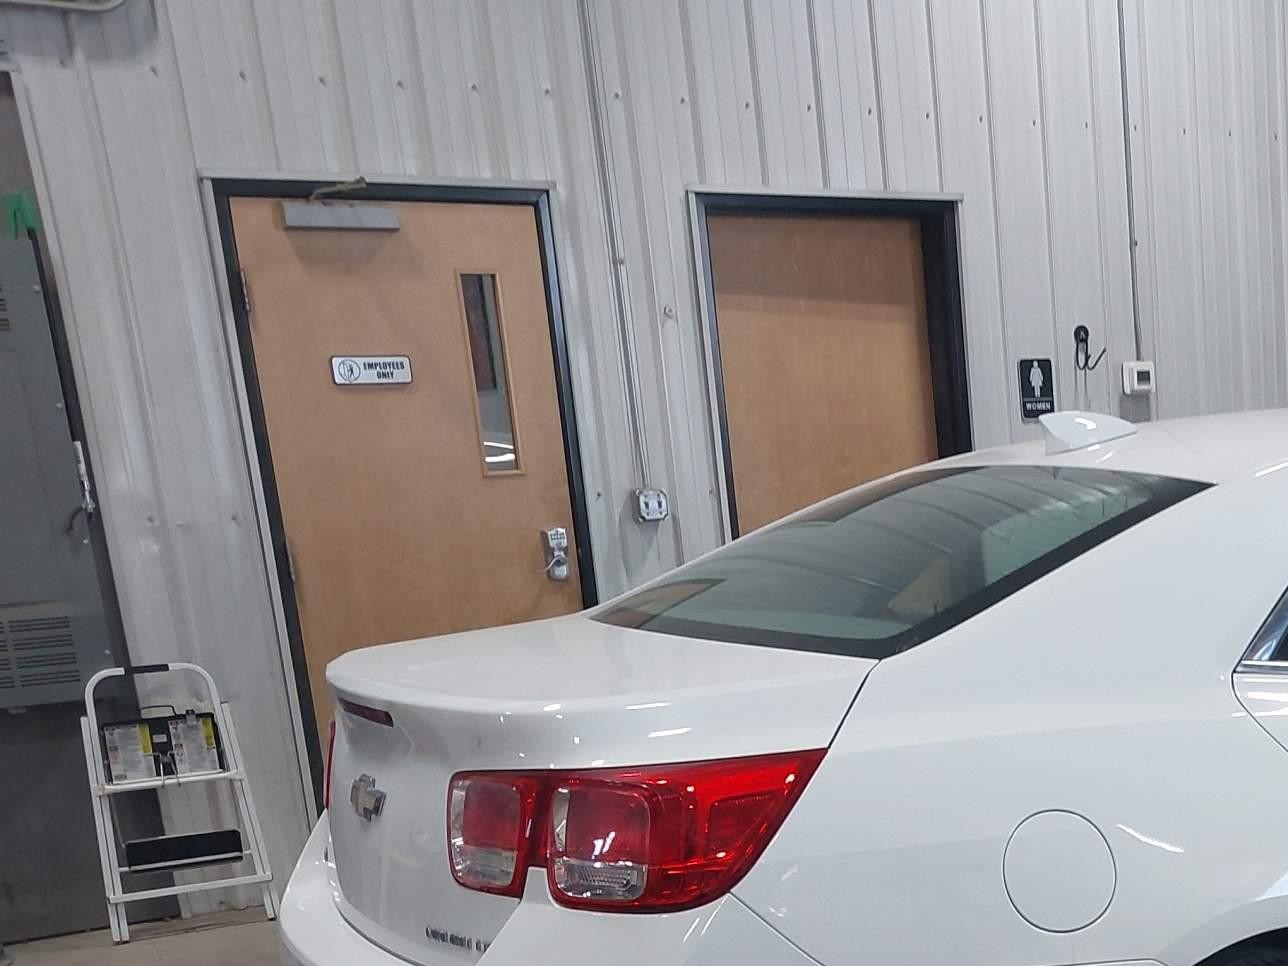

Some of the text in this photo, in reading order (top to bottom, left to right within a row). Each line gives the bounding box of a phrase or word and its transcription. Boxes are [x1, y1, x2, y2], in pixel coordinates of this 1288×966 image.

[363, 361, 405, 370] EMPLOYEES
[376, 371, 394, 379] ONLY
[1025, 402, 1051, 411] WOMEN
